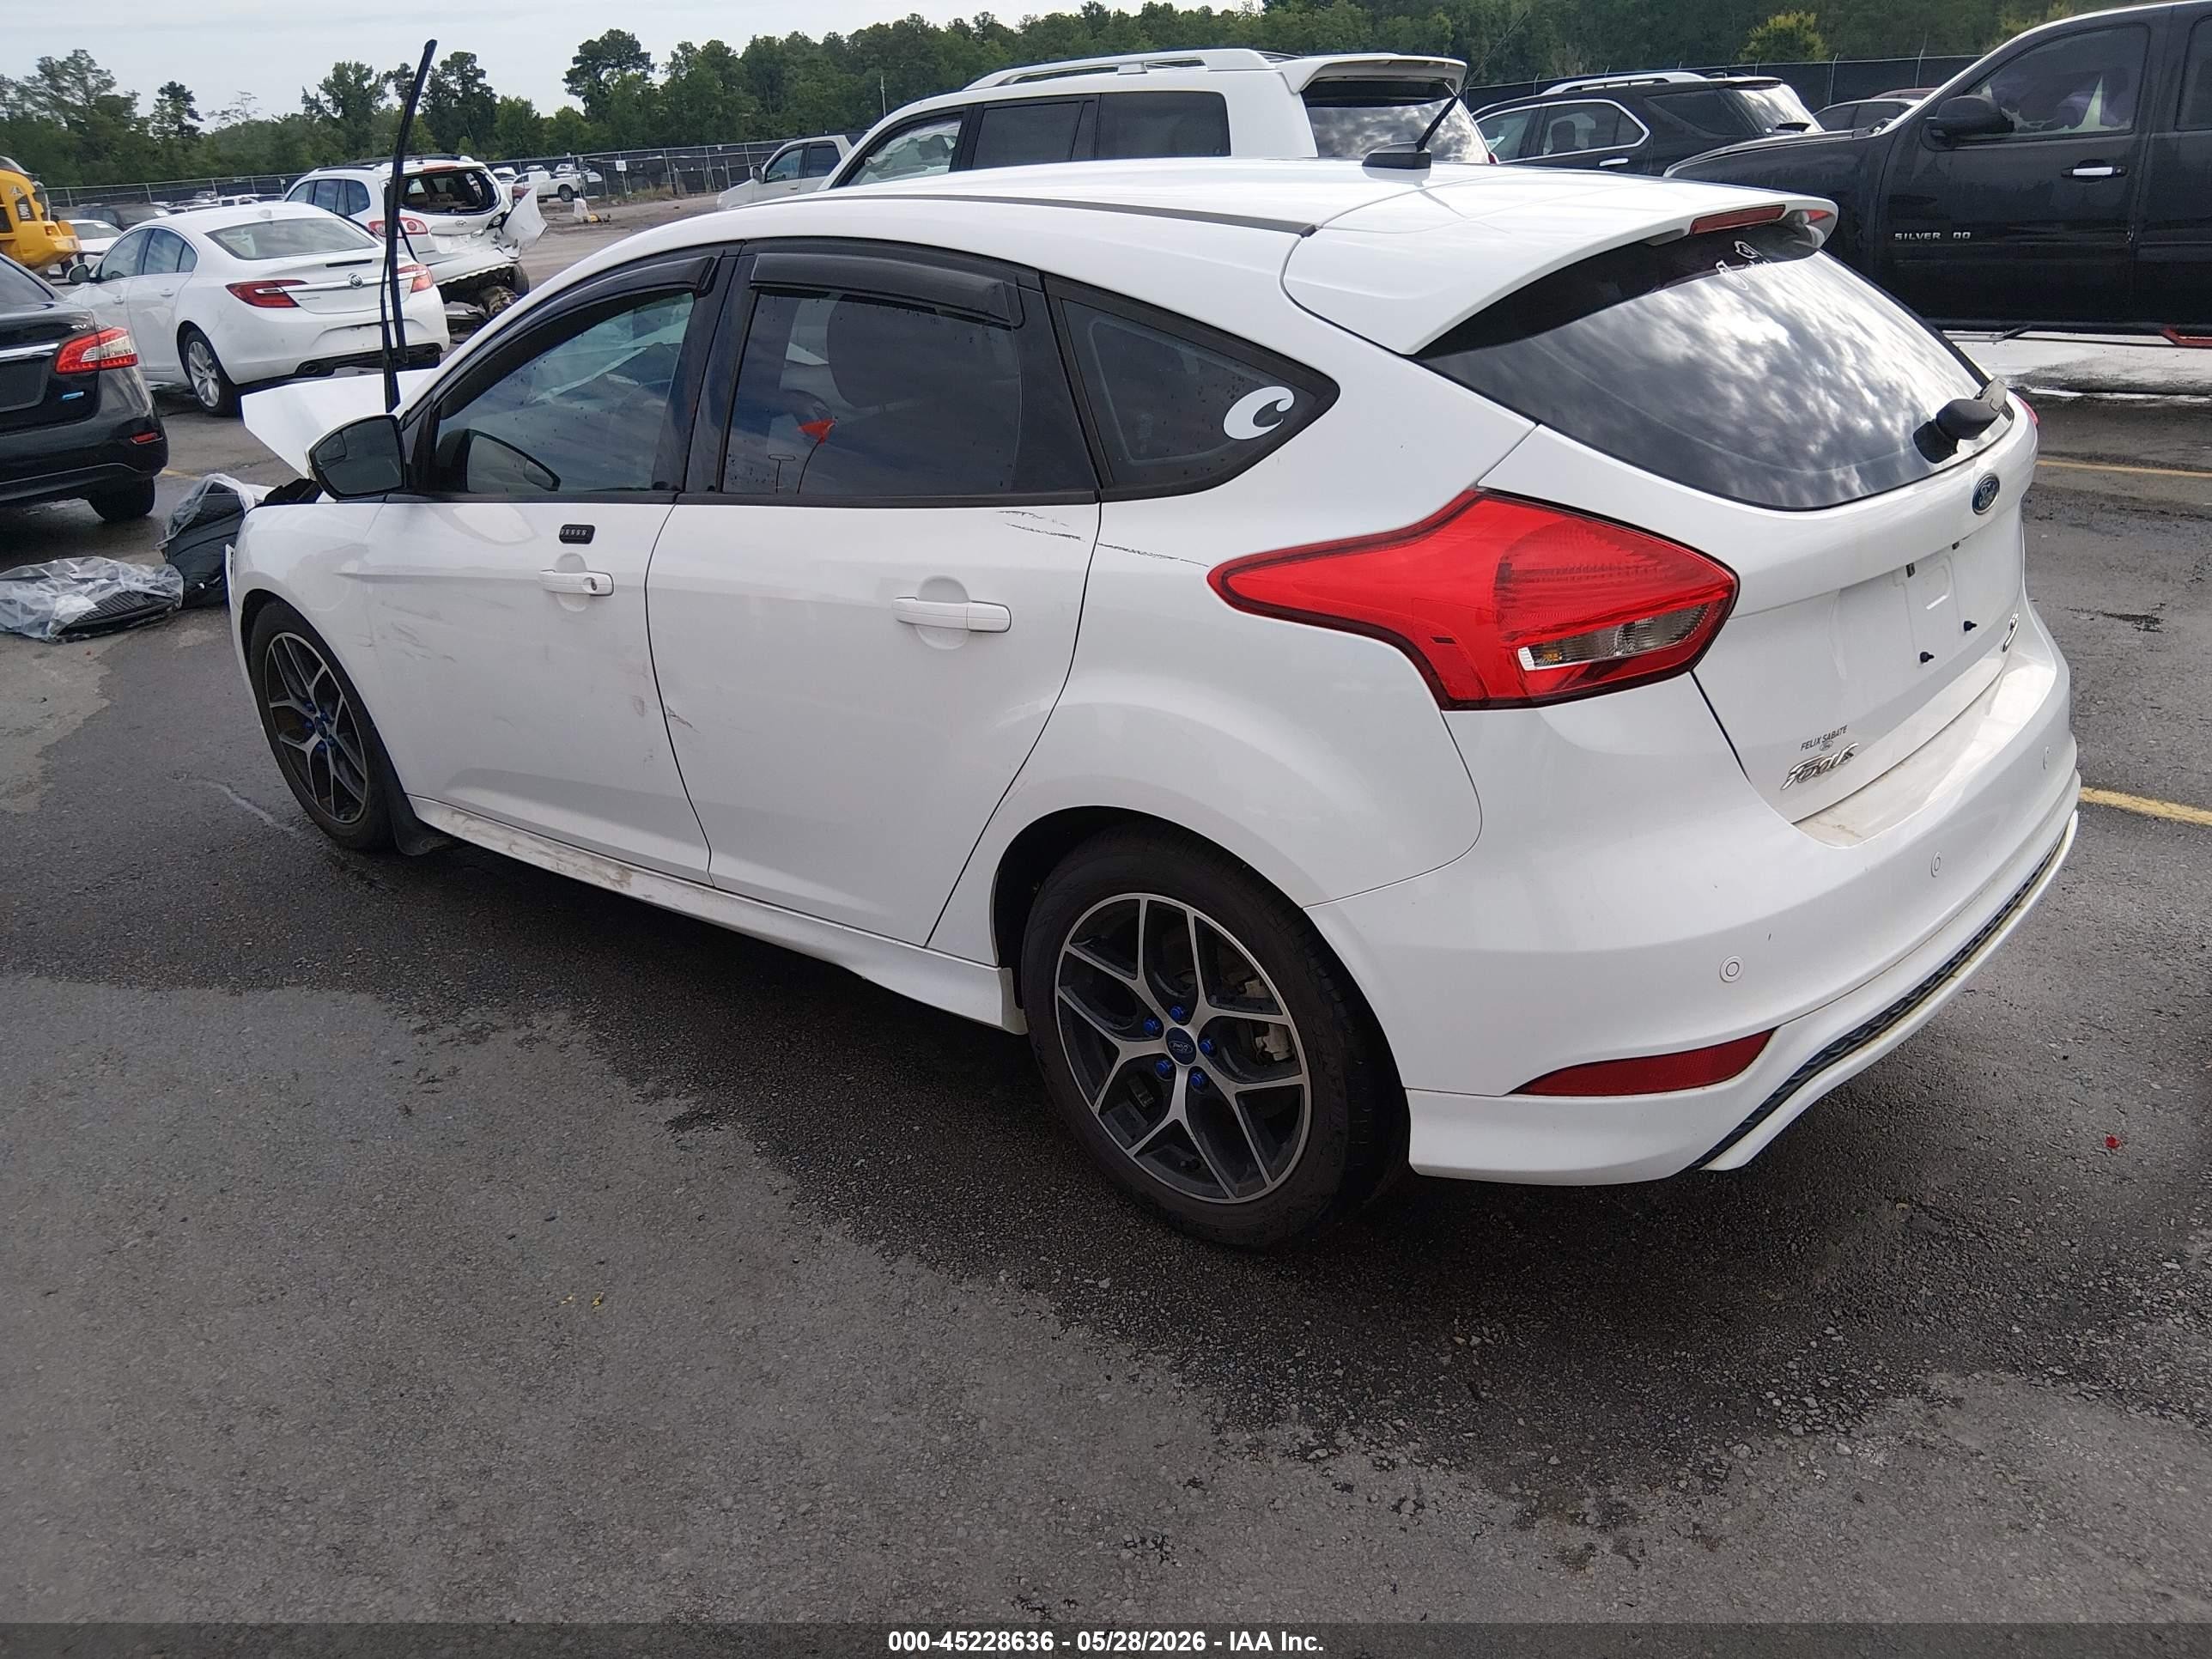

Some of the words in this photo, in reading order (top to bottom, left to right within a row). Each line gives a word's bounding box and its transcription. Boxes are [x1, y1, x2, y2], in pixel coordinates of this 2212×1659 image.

[1894, 232, 1942, 240] SILVER
[1801, 737, 1821, 750] FELIX
[1822, 725, 1847, 743] SABATE
